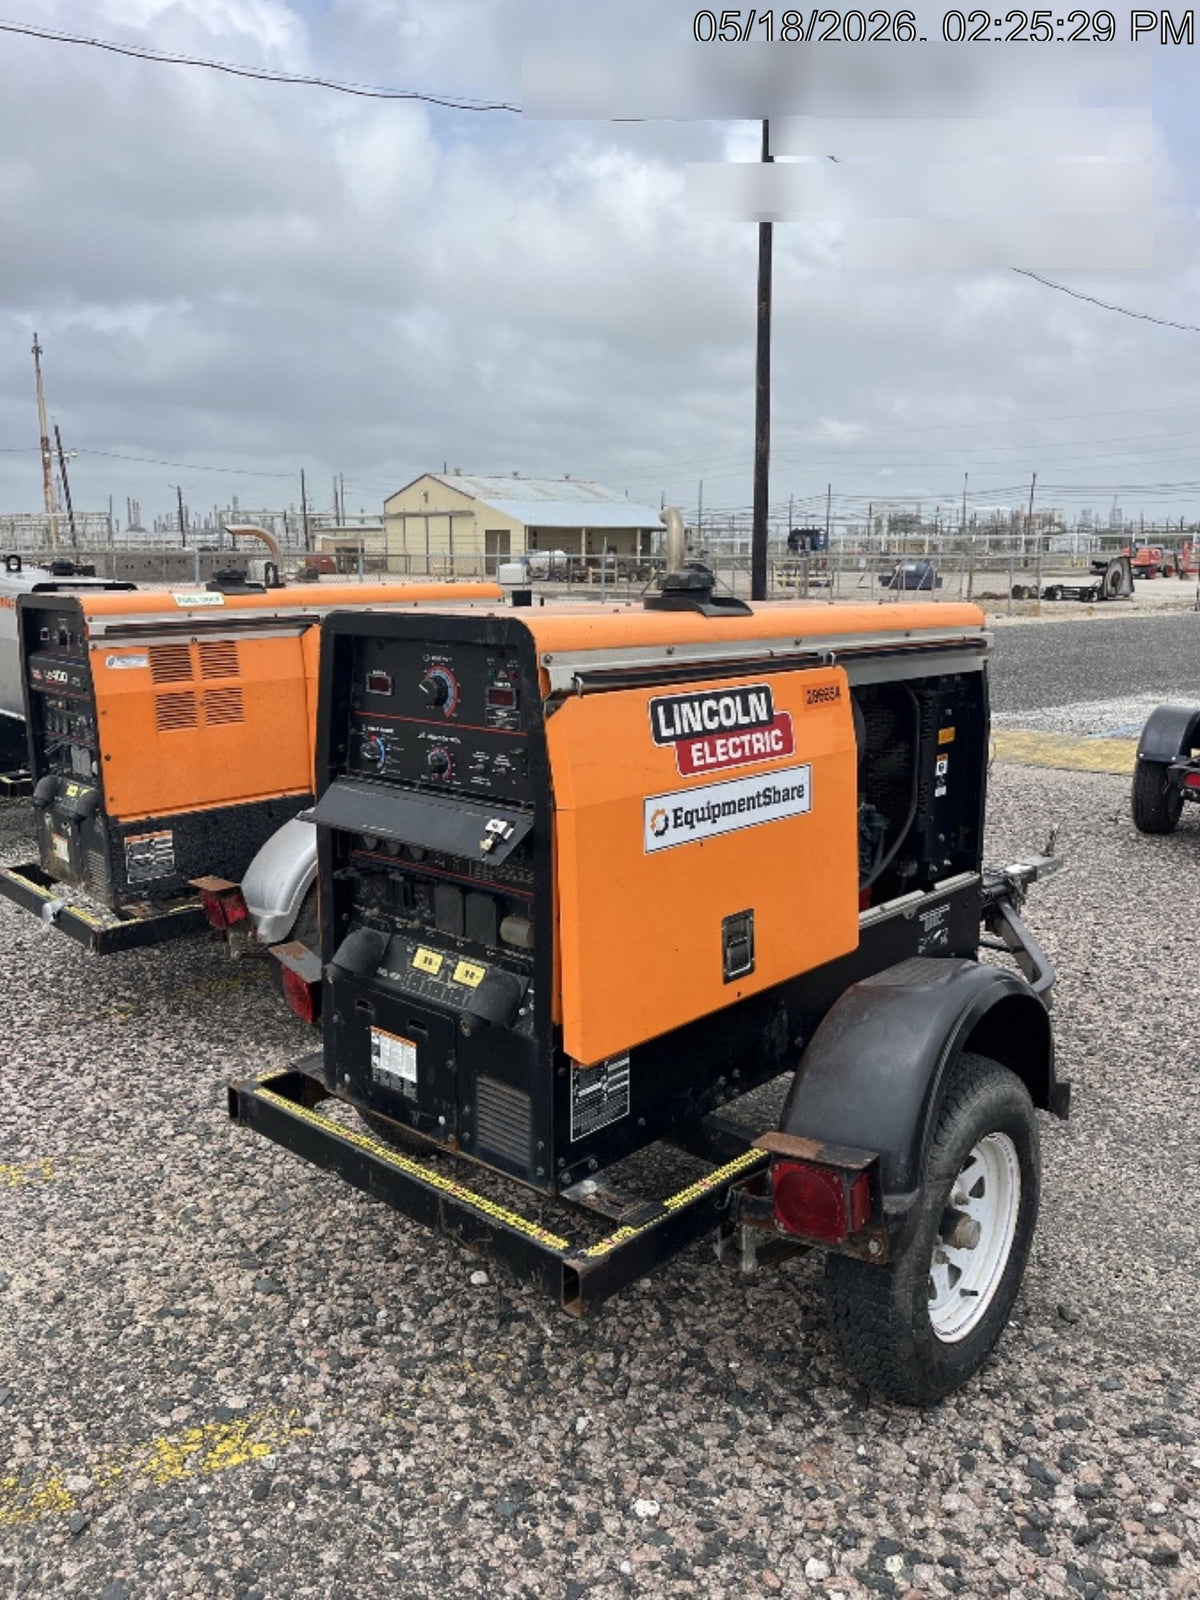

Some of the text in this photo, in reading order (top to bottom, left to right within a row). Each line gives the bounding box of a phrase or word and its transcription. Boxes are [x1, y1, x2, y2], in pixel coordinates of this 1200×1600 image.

[657, 693, 769, 737] LINCOLN
[691, 729, 783, 767] ELECTRIC
[673, 784, 805, 829] EquipmentShare
